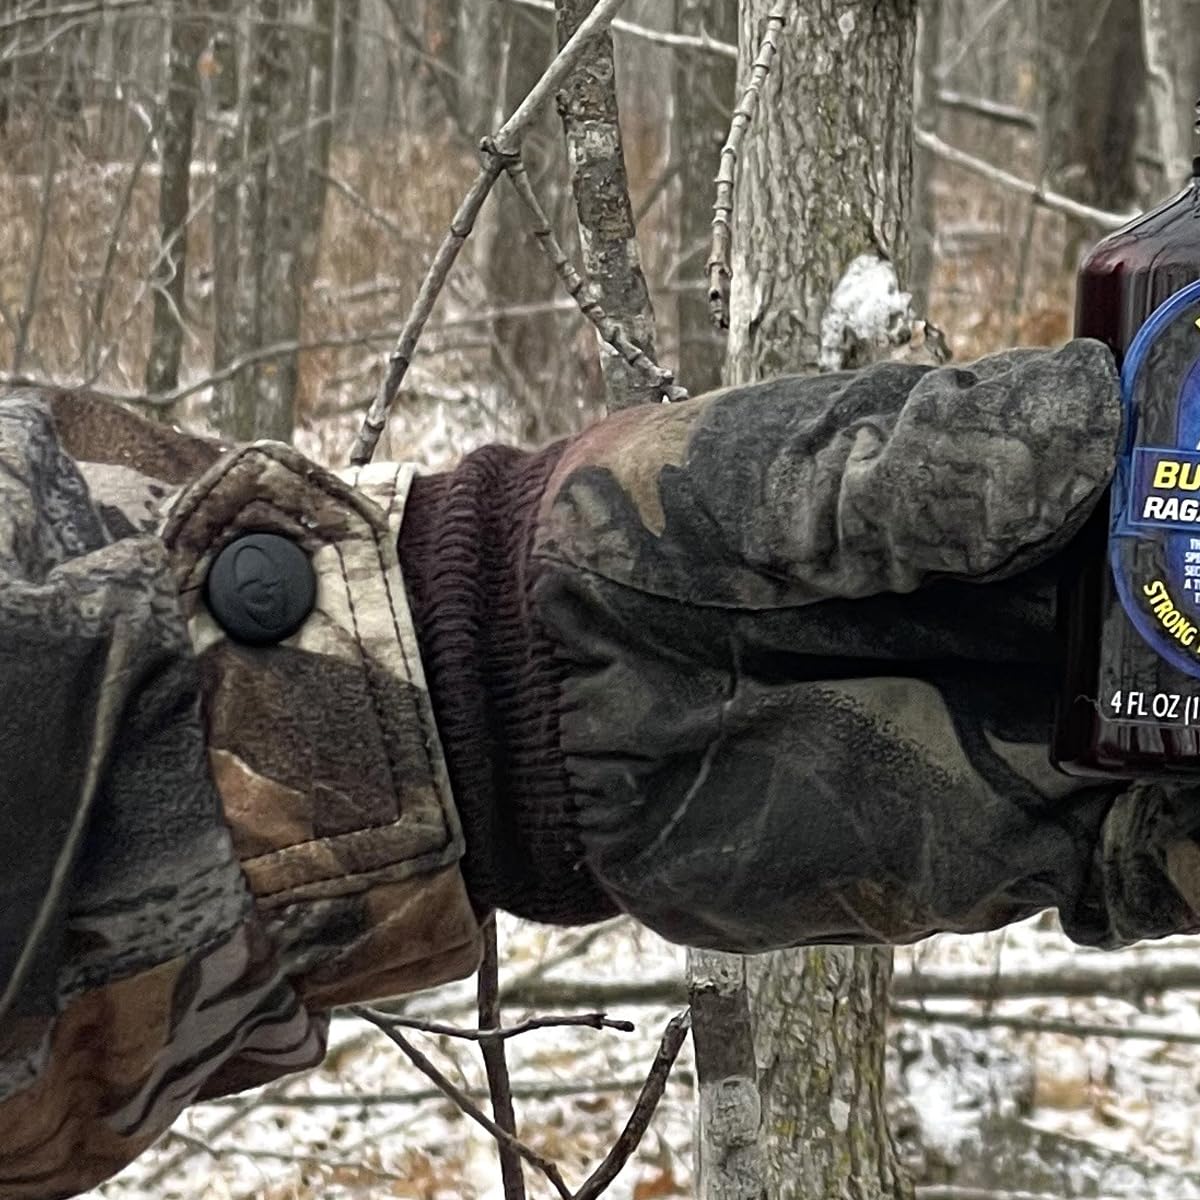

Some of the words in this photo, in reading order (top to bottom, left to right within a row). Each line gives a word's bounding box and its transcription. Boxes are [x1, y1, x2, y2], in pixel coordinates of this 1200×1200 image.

[1184, 578, 1192, 589] A
[1143, 580, 1198, 646] STRONG
[1110, 690, 1122, 714] 4
[1127, 692, 1148, 716] FL
[1152, 694, 1181, 718] OZ
